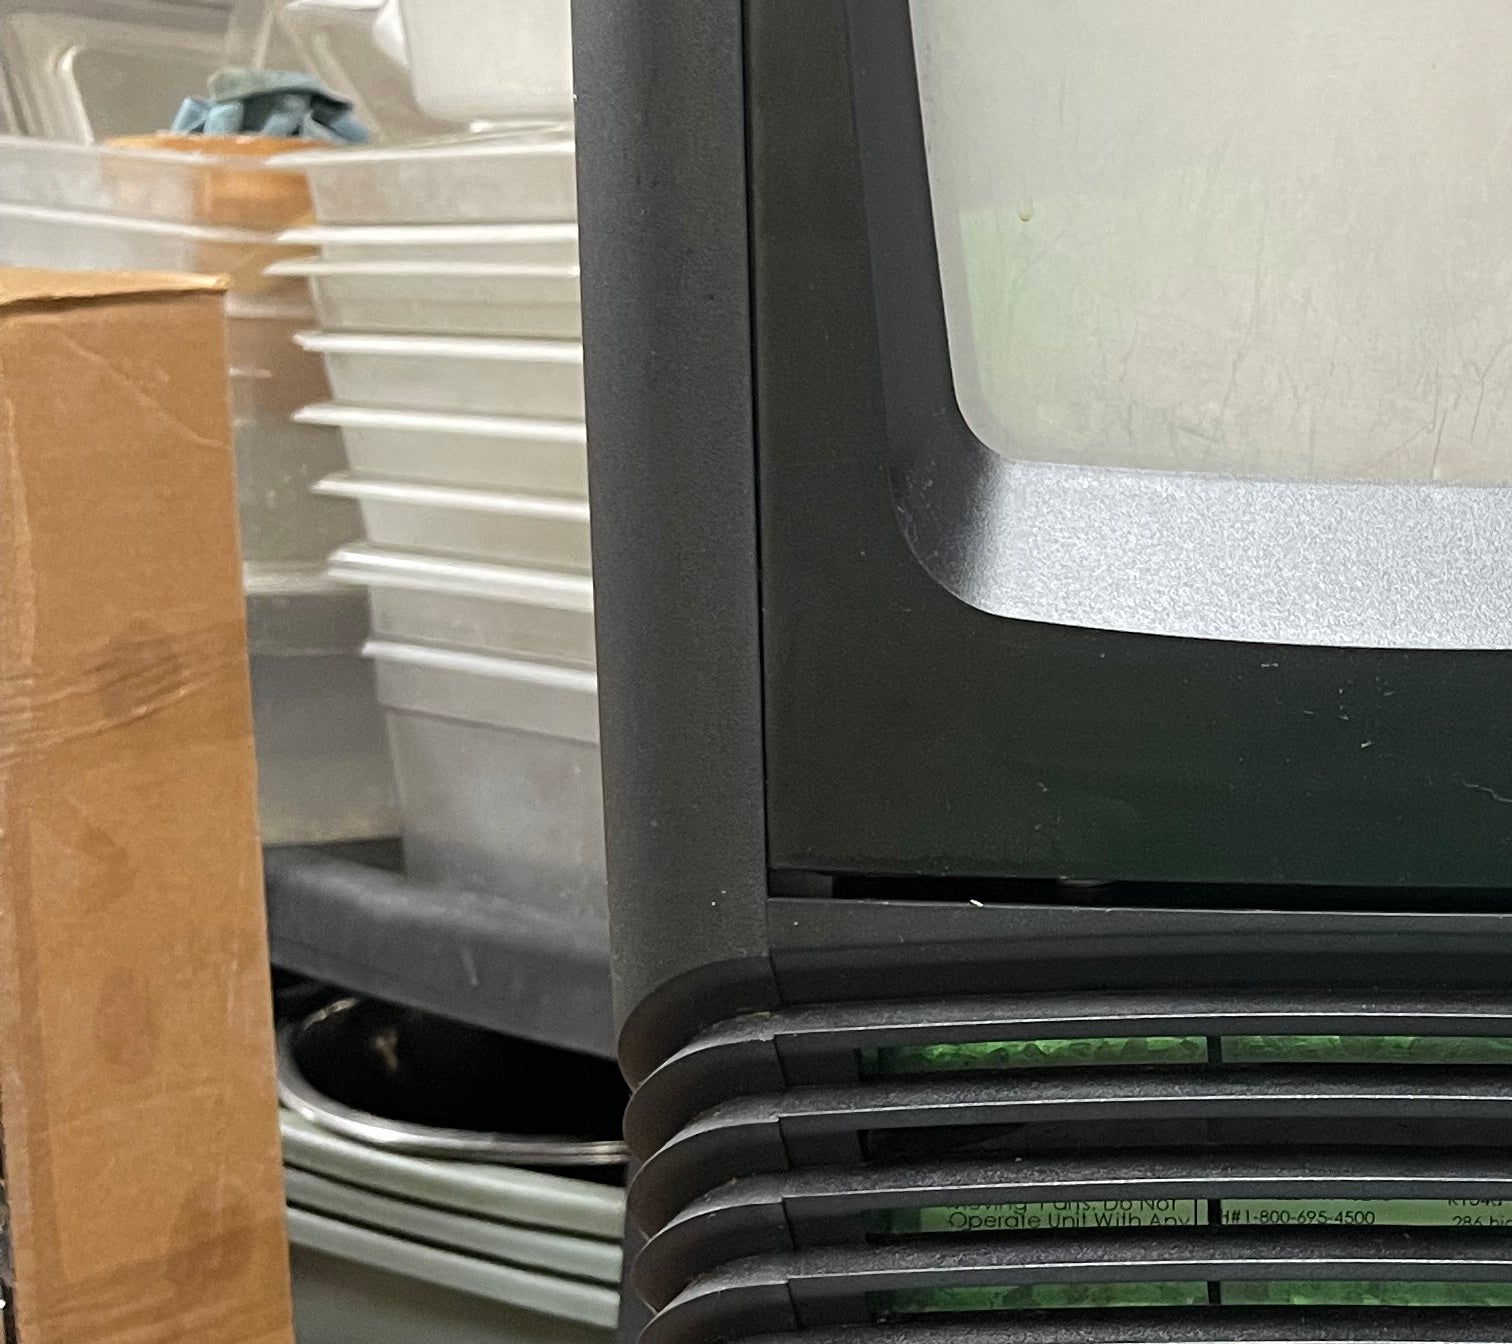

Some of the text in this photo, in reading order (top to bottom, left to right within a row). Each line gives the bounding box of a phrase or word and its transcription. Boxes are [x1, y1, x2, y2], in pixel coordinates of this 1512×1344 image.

[948, 1212, 1041, 1231] Operate
[1047, 1212, 1087, 1227] Unit
[1094, 1212, 1142, 1226] With
